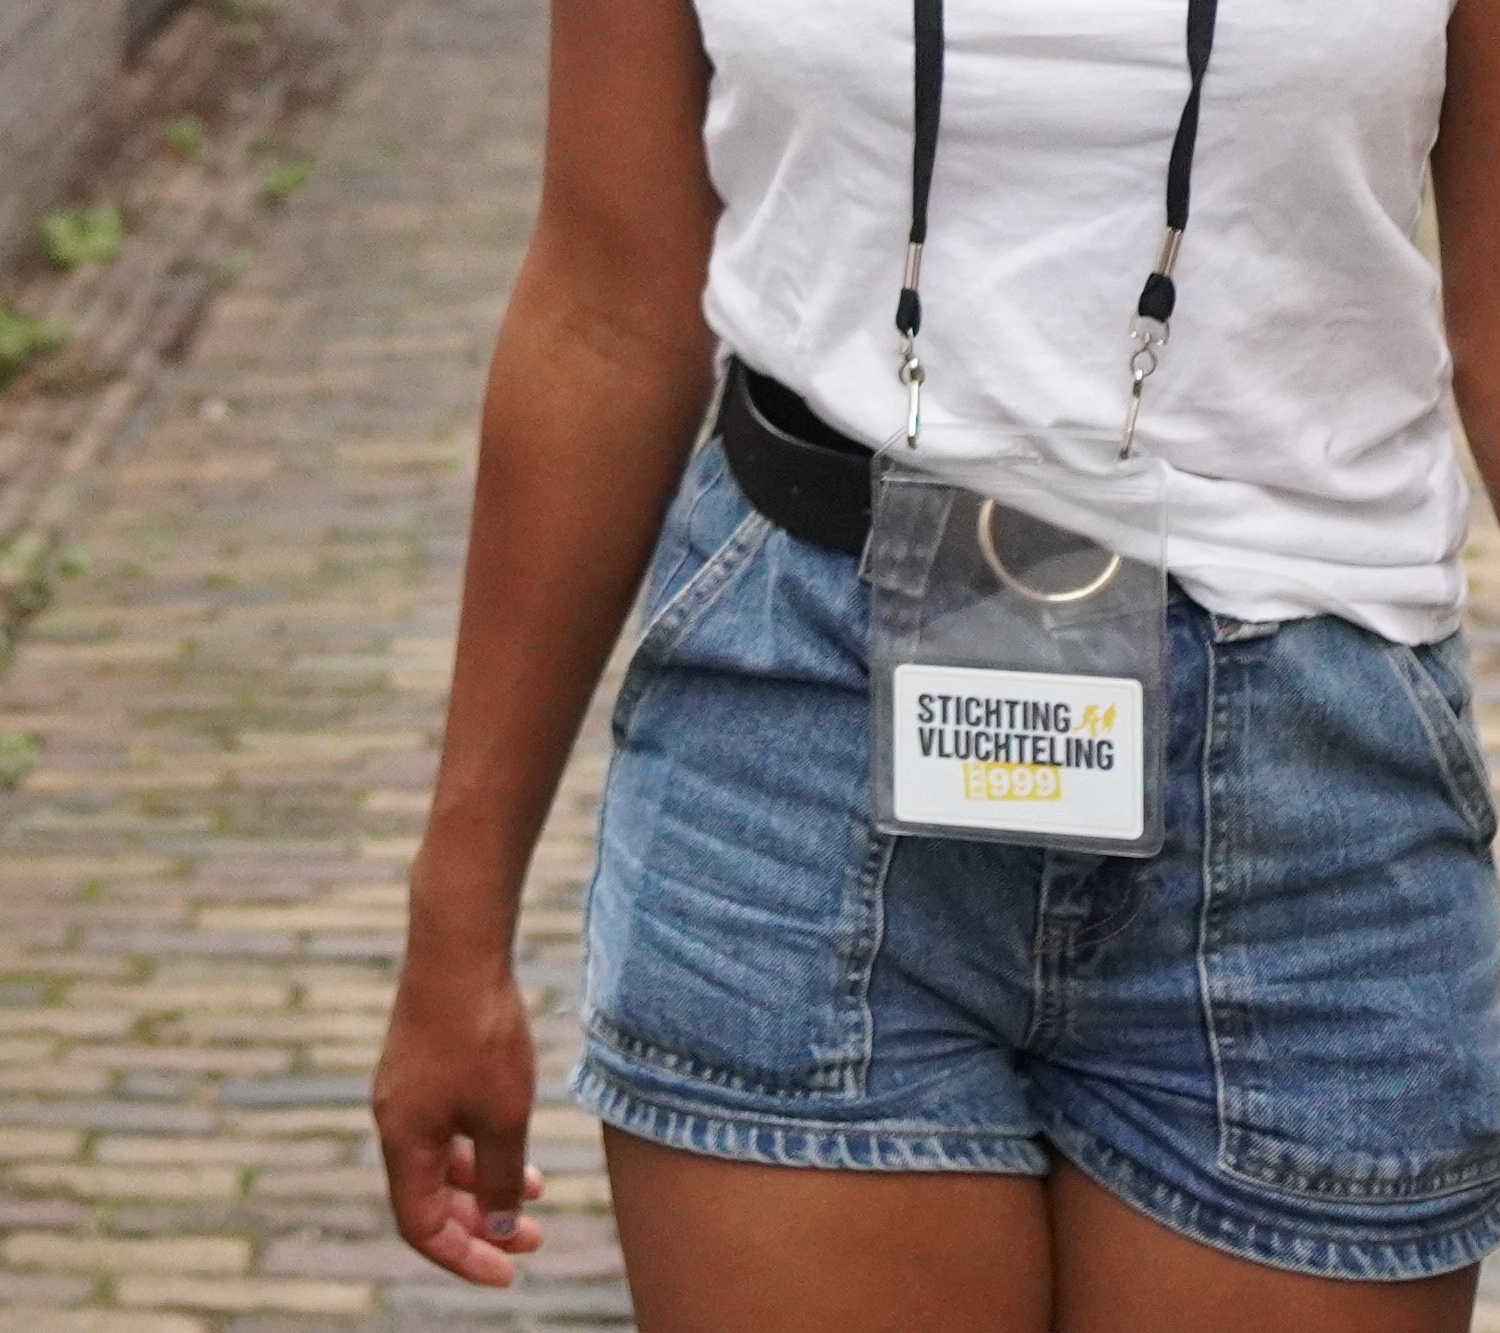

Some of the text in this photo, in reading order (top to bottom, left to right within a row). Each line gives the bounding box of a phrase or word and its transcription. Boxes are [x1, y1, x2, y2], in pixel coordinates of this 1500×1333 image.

[917, 693, 1071, 732] STICHTING
[917, 727, 1115, 771] VLUCHTELING
[989, 767, 1056, 797] 999
